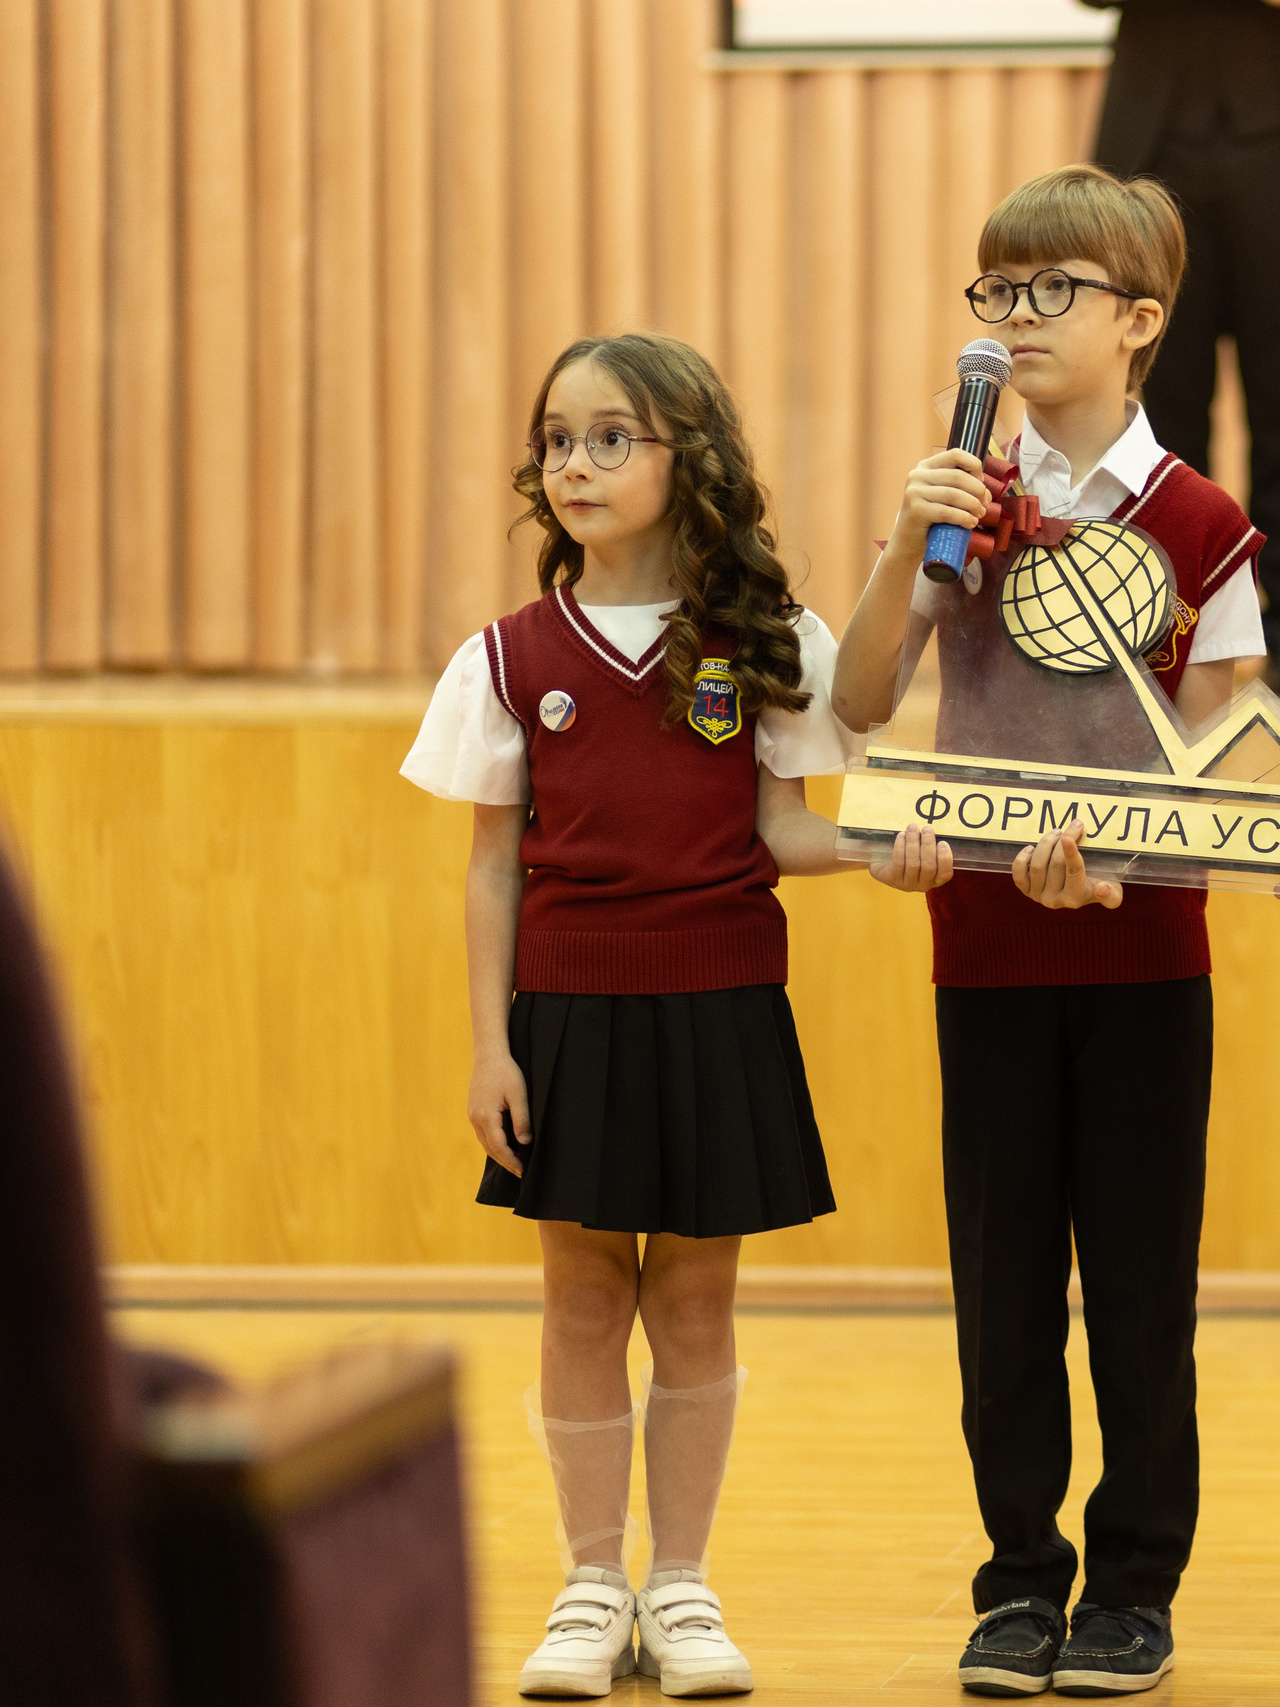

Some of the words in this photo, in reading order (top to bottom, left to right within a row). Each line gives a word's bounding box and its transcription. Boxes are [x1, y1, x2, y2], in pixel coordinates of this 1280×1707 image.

[697, 681, 734, 695] ЛИЦЕЙ
[703, 694, 729, 718] 14
[915, 789, 1189, 846] ФОРМУЛА
